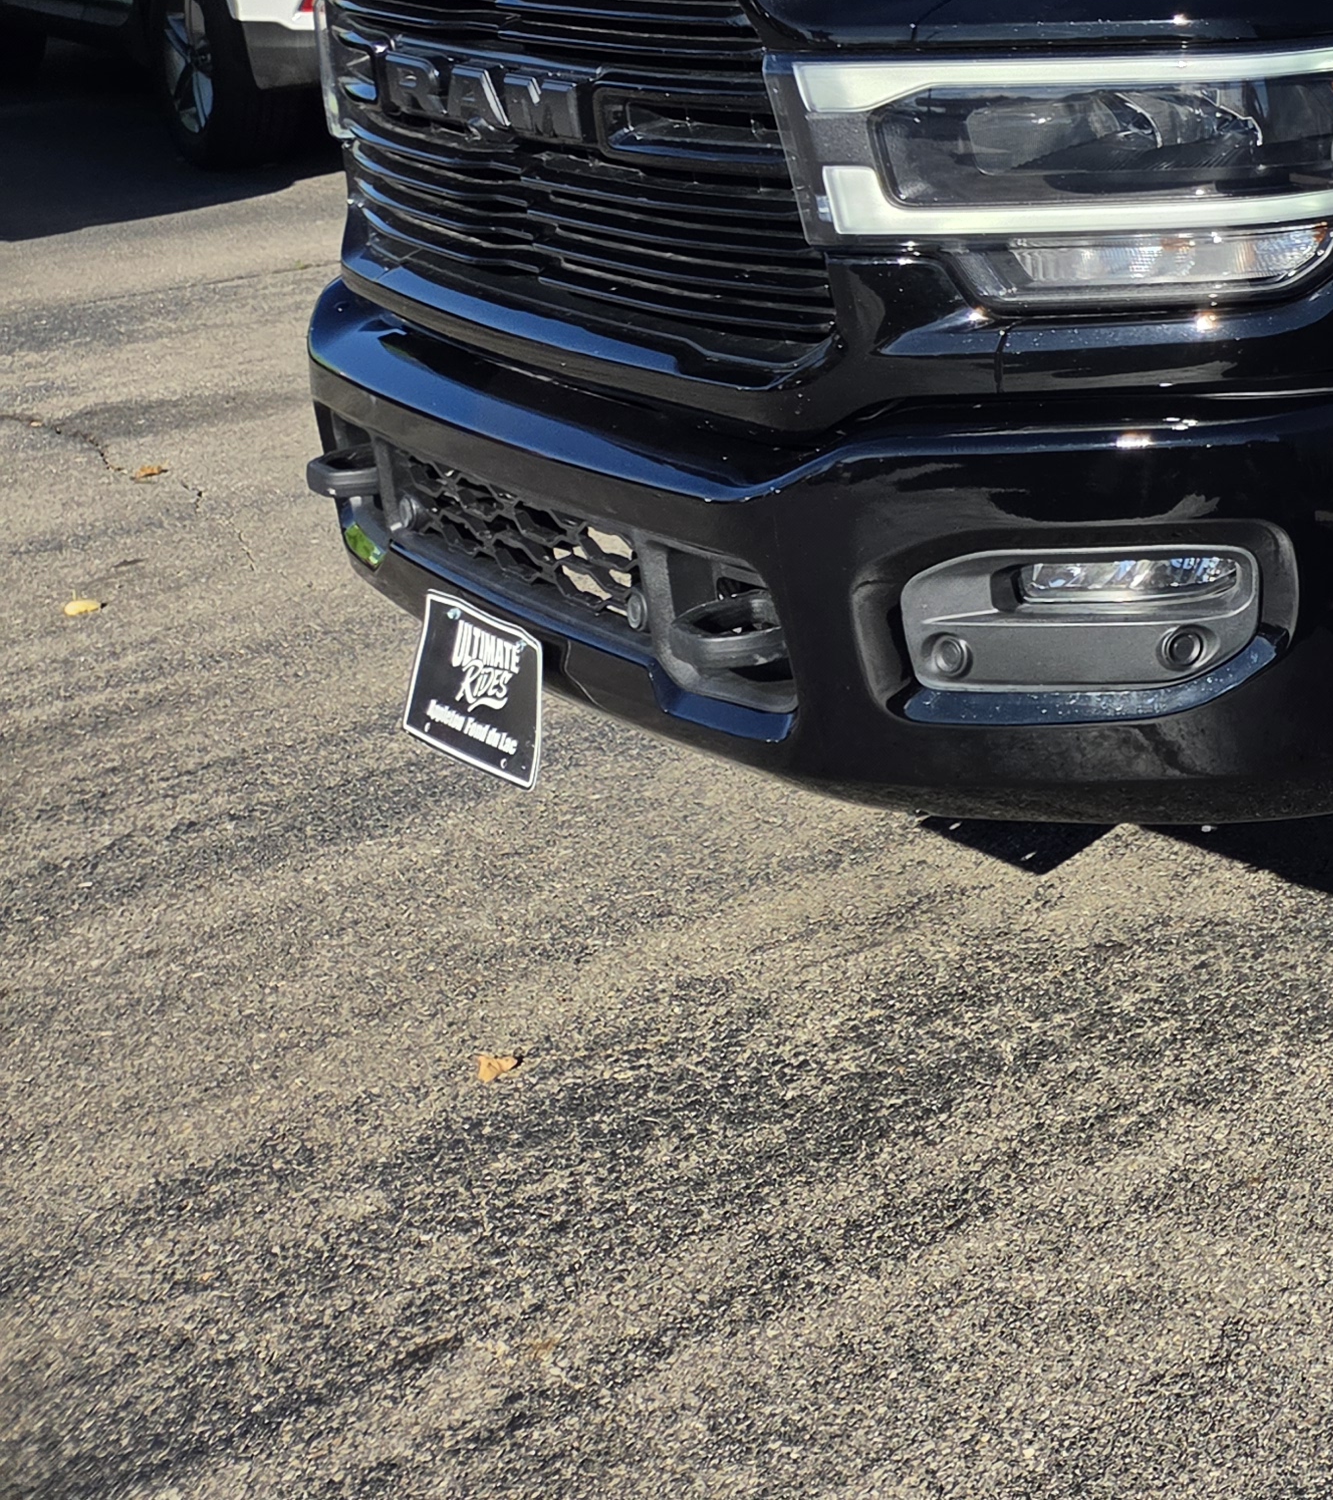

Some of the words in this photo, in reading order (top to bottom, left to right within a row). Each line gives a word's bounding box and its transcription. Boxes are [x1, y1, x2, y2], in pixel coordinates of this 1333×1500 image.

[383, 52, 582, 140] RAM
[452, 619, 521, 674] ULTIMATE
[455, 659, 513, 706] RIDES
[463, 716, 490, 743] Fond
[485, 727, 502, 748] du
[498, 732, 518, 756] Lac
